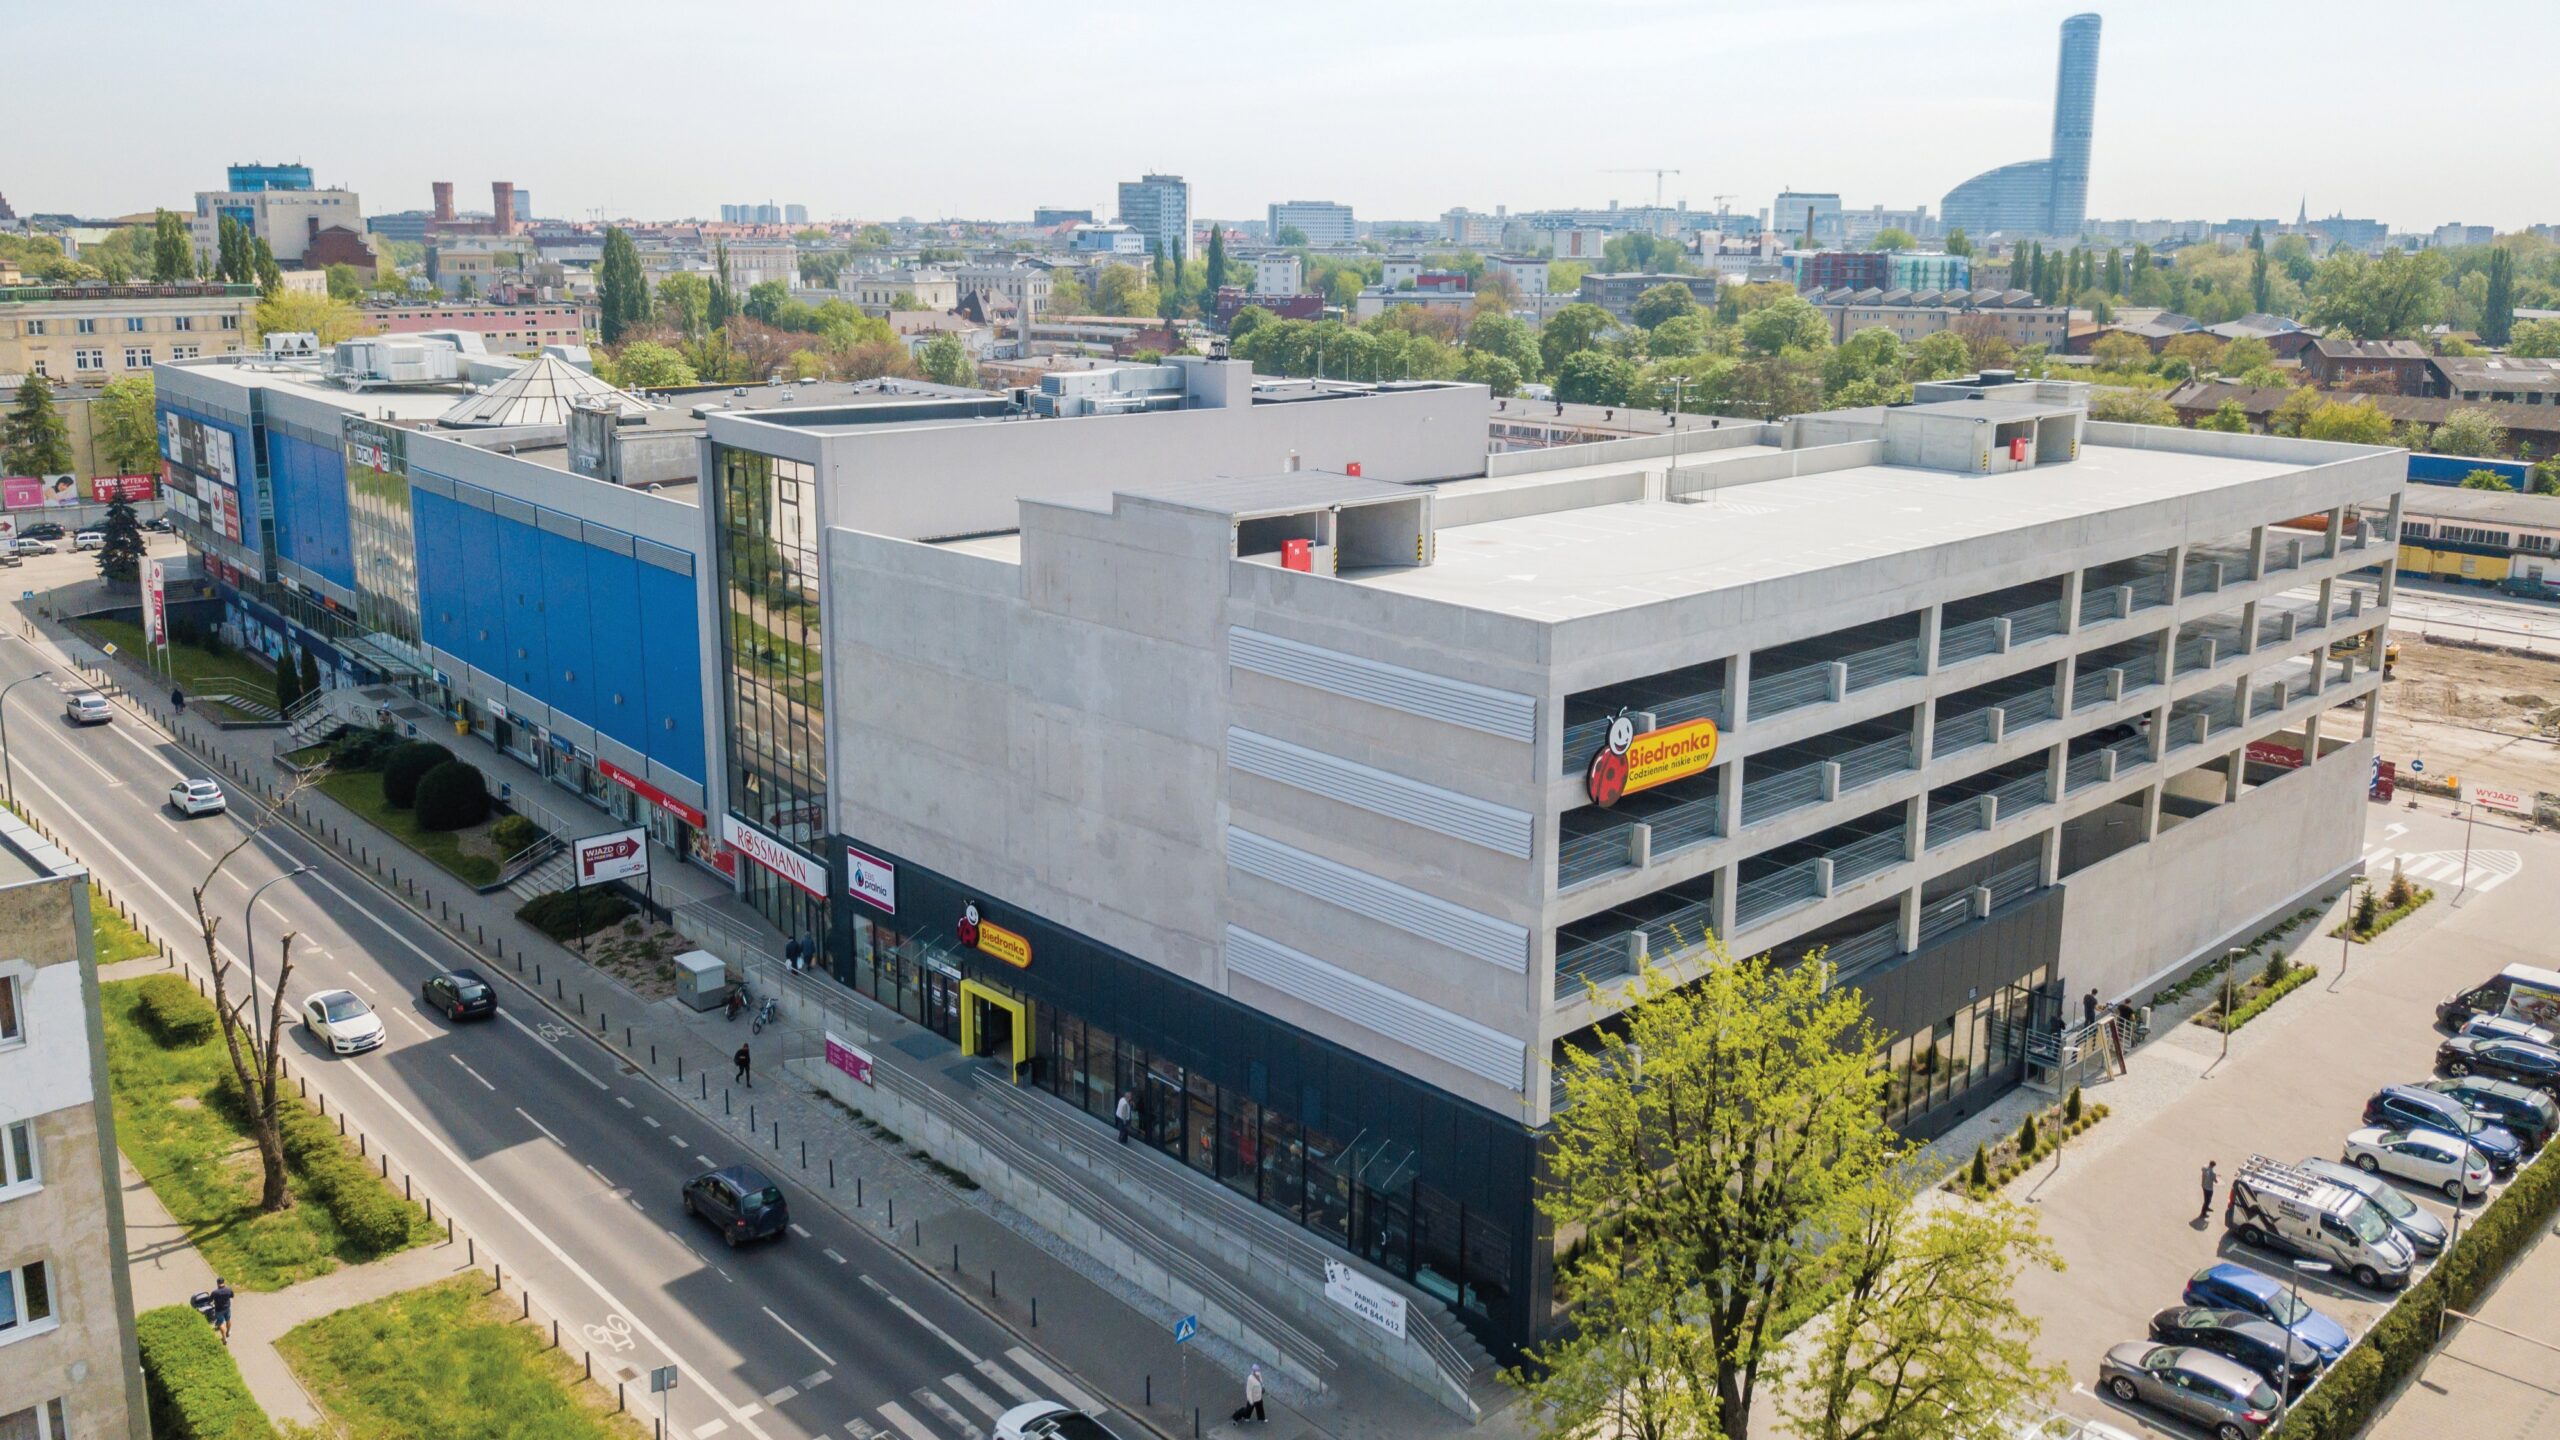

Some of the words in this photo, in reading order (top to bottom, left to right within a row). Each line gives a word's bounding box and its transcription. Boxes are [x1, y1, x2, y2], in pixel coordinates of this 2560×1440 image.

[1630, 732, 1710, 769] Biedronka
[1629, 762, 1669, 781] Codziennie
[1671, 756, 1691, 769] niskie
[1693, 751, 1710, 763] ceny
[2476, 787, 2519, 803] WYJAZD
[586, 846, 614, 858] WJAZD
[737, 826, 807, 883] ROSSMANN
[864, 881, 887, 897] pralnia
[982, 927, 1025, 956] Biedronka
[1354, 1291, 1378, 1309] PARKUJ
[1354, 1301, 1368, 1315] 664
[1370, 1309, 1384, 1323] 844
[1385, 1318, 1399, 1331] 612
